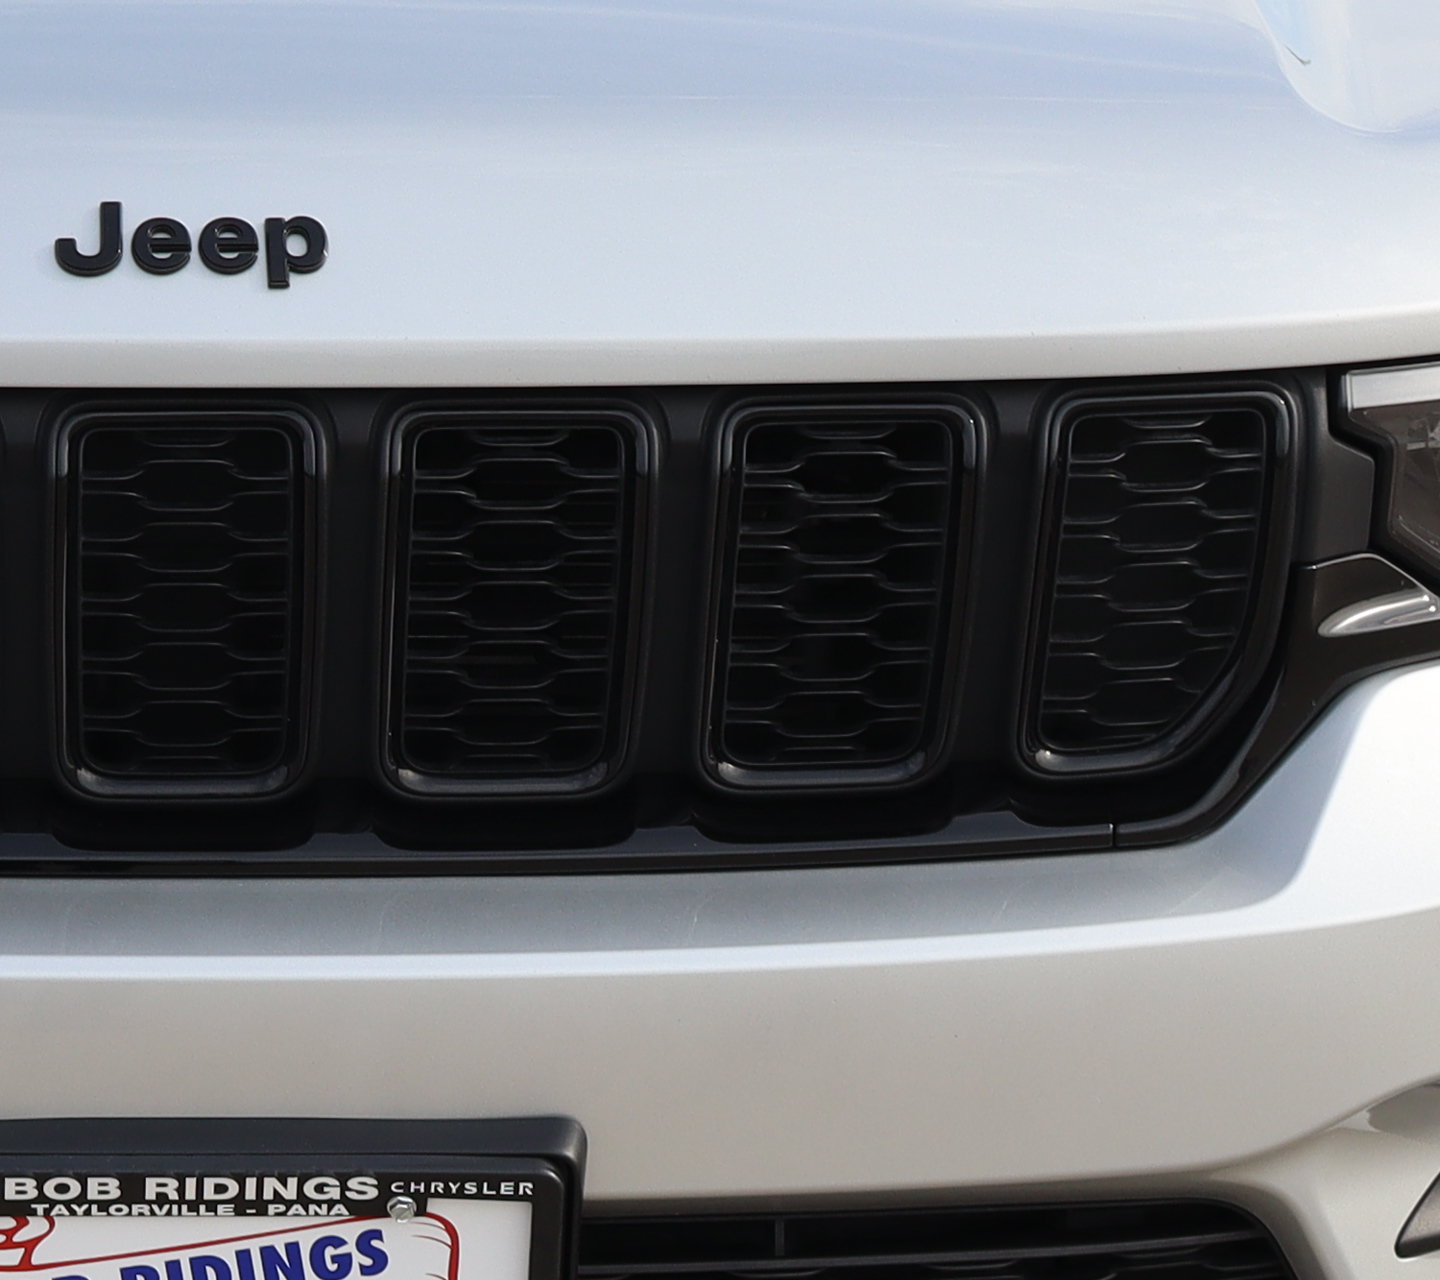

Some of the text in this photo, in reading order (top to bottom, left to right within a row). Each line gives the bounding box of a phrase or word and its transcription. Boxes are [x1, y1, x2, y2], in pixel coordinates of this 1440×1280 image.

[54, 200, 330, 290] Jeep
[4, 1175, 380, 1201] BOB RIDINGS
[390, 1181, 535, 1197] CHRYSLER
[31, 1204, 235, 1217] TAYLORVILLE
[268, 1204, 351, 1216] PANA
